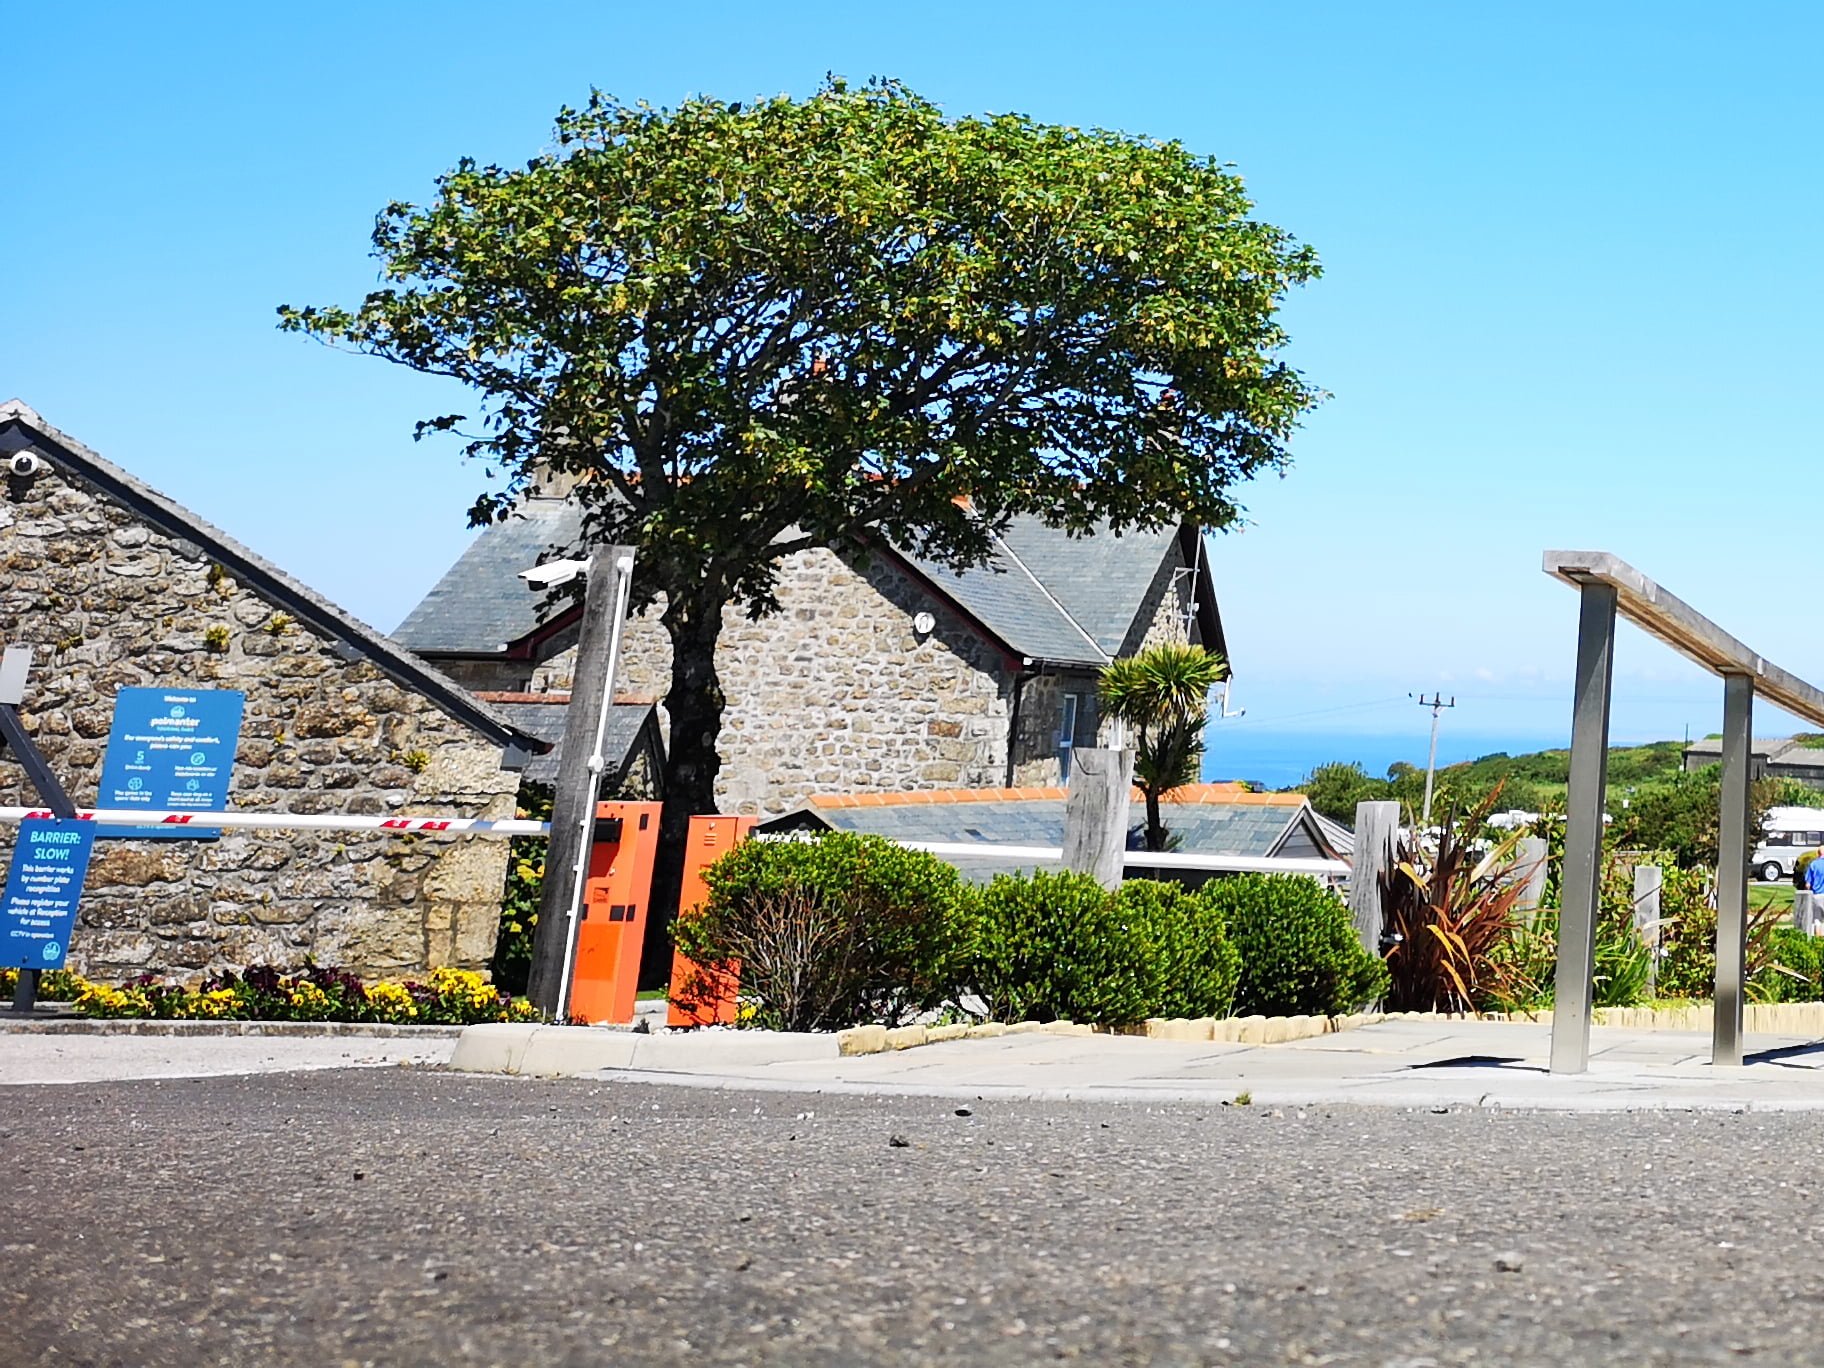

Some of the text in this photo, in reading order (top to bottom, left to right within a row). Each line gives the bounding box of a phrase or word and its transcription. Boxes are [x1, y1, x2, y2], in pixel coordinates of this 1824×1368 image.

[150, 717, 200, 727] polmanter
[136, 750, 145, 761] 5
[30, 831, 82, 844] BARRIER:
[34, 848, 70, 860] SLOW!
